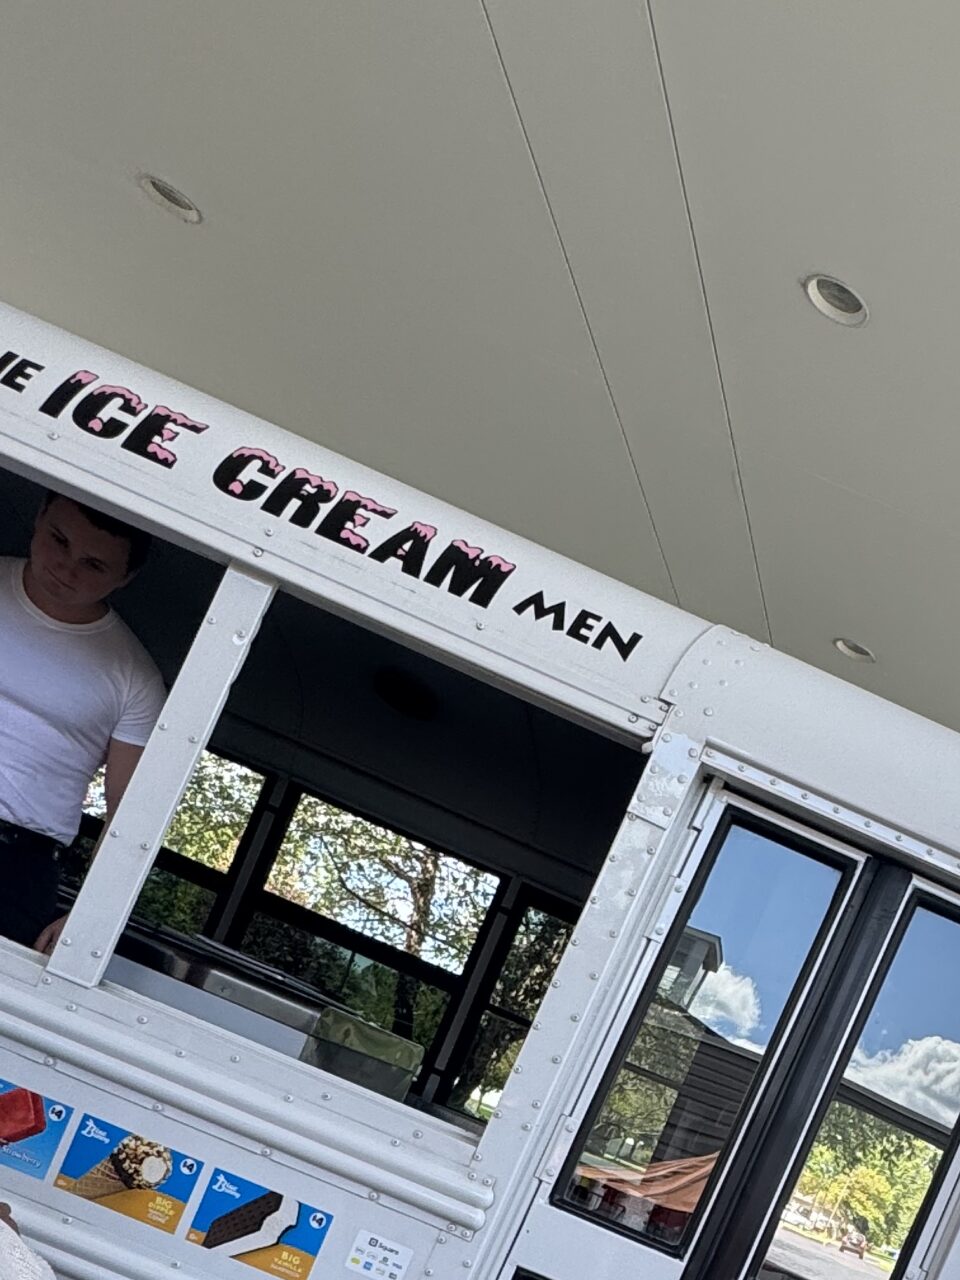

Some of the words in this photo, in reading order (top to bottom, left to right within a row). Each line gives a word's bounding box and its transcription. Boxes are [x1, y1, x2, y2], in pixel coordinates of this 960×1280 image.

[0, 350, 46, 394] E
[38, 369, 211, 470] ICE
[212, 445, 517, 610] CREAM
[511, 590, 643, 663] MEN
[155, 1196, 174, 1210] BIG
[312, 1215, 324, 1227] $4
[281, 1250, 302, 1266] BIG
